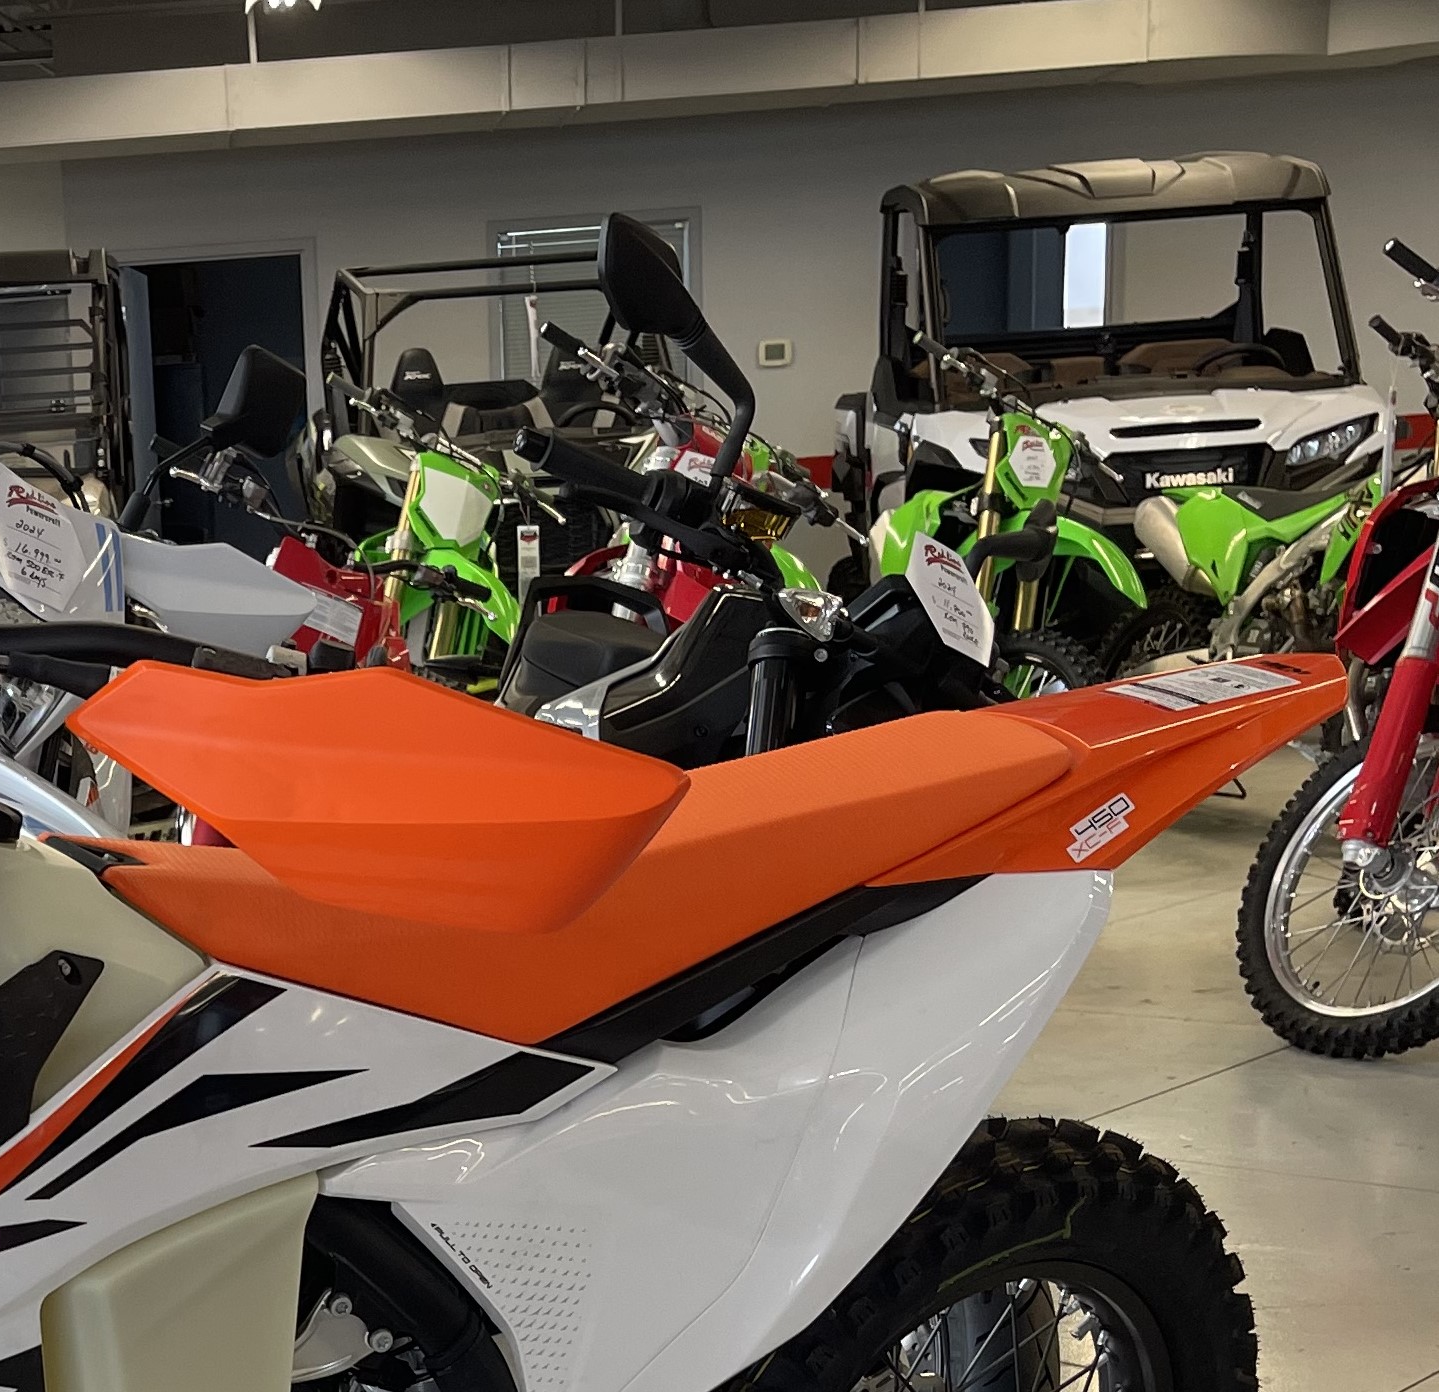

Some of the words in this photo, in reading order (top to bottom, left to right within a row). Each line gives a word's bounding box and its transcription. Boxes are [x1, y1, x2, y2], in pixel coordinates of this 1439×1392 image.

[1145, 467, 1235, 490] Kawasaki
[15, 519, 45, 538] 2024
[1074, 796, 1130, 836] 450
[1071, 817, 1122, 859] XC-F
[434, 1226, 456, 1252] PULL
[457, 1250, 471, 1265] TO
